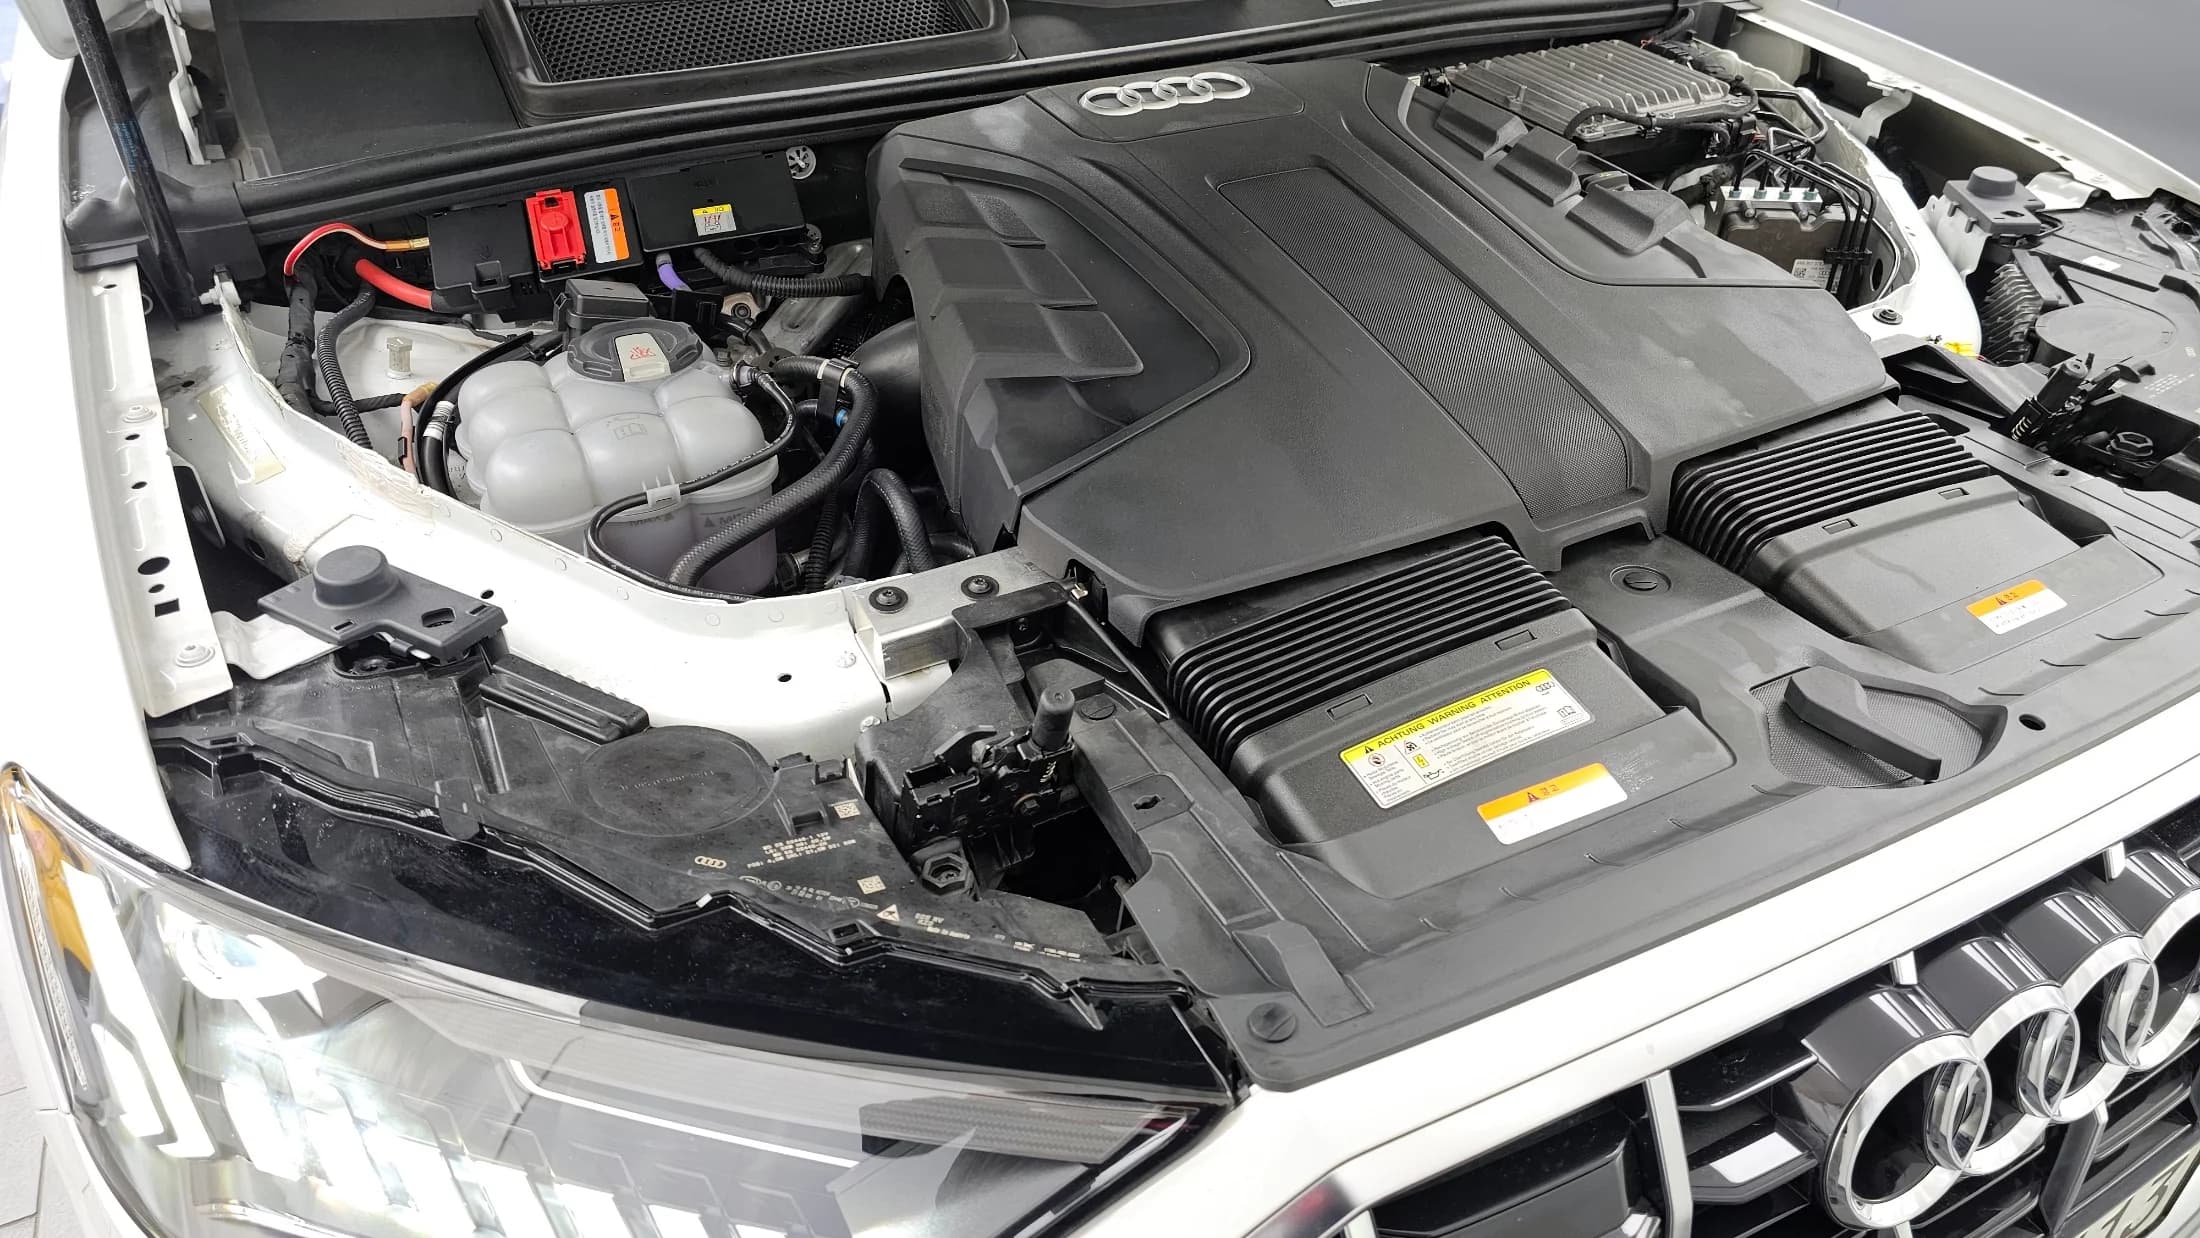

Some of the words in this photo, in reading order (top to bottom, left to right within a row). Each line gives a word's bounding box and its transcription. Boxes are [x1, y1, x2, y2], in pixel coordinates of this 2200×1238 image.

[1377, 722, 1425, 748] ACHTUNG
[1428, 701, 1477, 725] WARNING
[1479, 679, 1531, 704] ATTENTION
